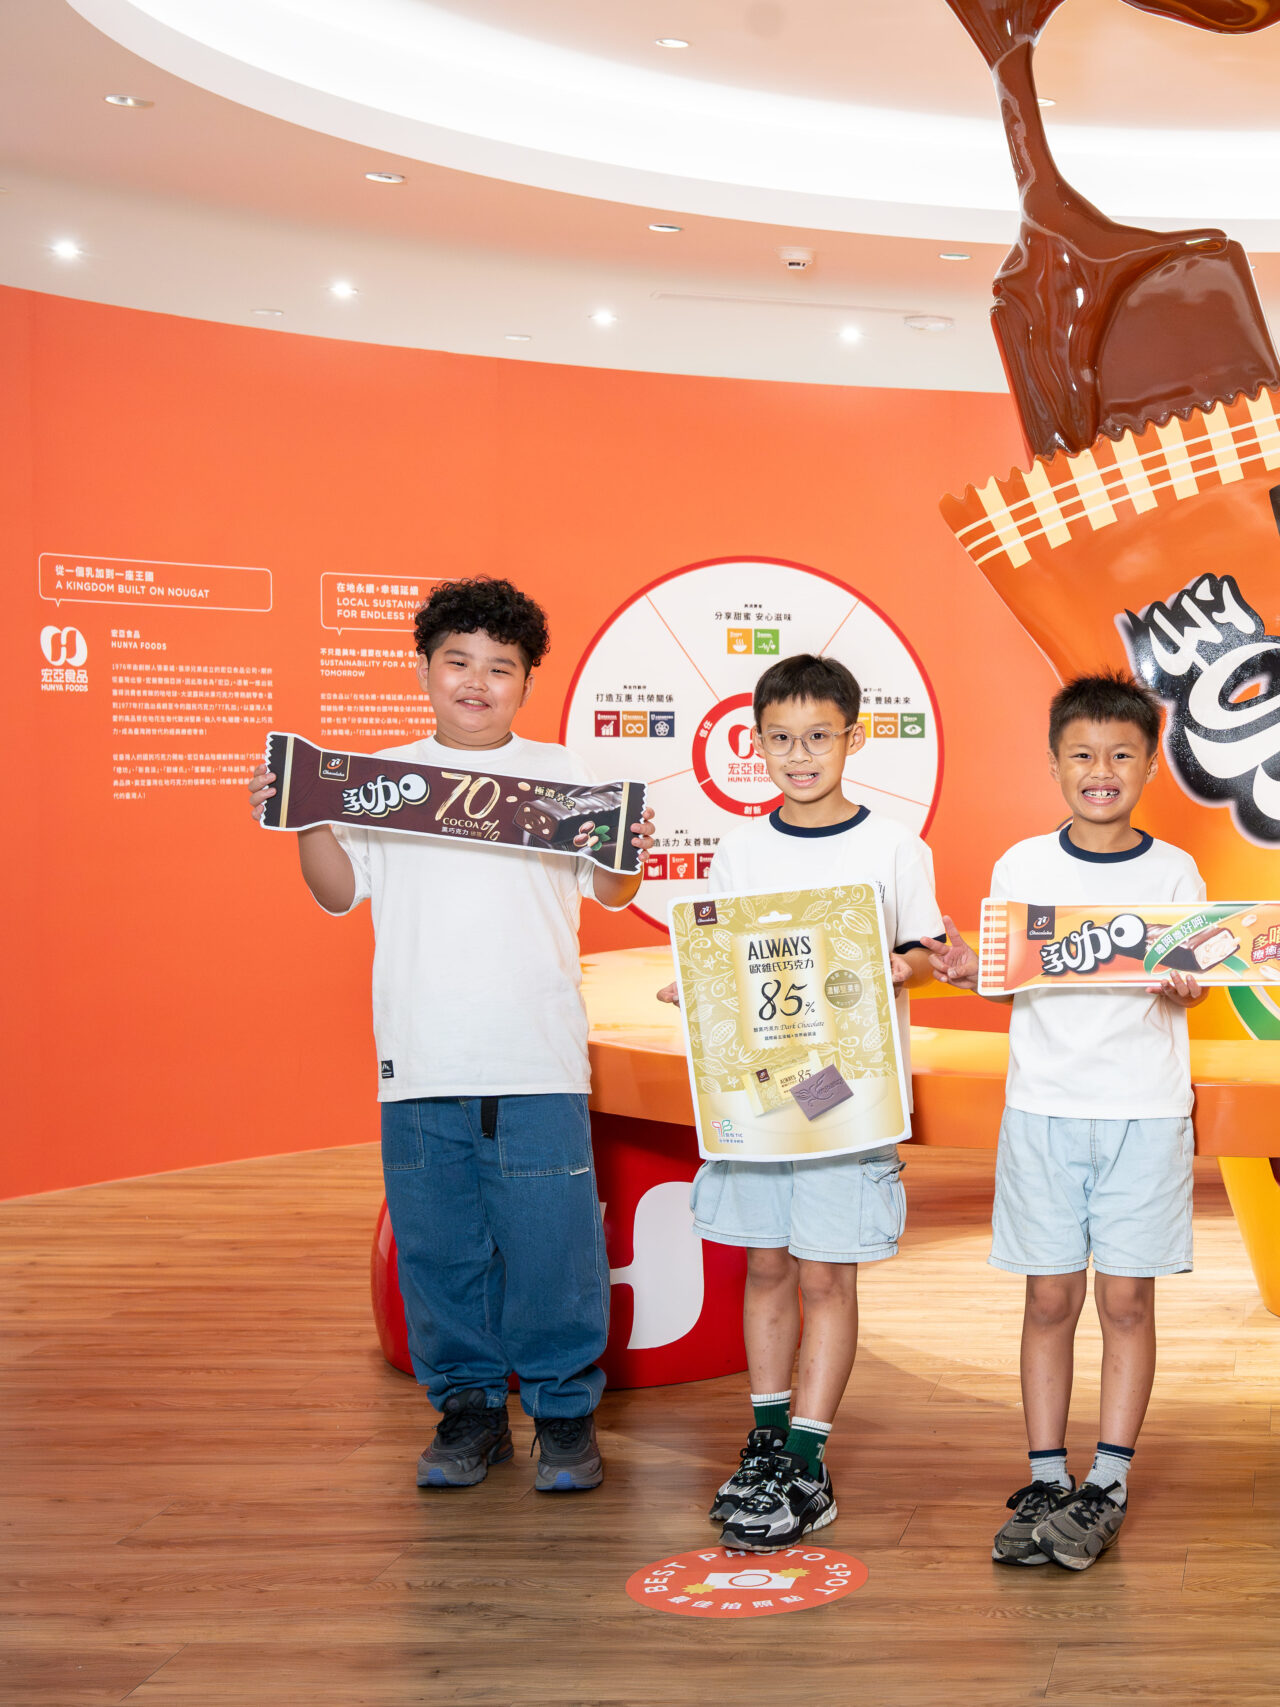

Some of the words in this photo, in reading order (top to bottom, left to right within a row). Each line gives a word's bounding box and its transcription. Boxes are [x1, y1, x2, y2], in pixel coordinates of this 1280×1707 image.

[55, 580, 63, 590] A
[66, 580, 115, 593] KINGDOM
[117, 583, 146, 595] BUILT
[149, 586, 165, 596] ON
[167, 586, 210, 599] NOUGAT
[336, 597, 370, 607] LOCAL
[372, 599, 422, 609] SUSTAINA
[336, 609, 358, 618] FOR
[360, 611, 405, 620] ENDLESS
[111, 640, 138, 650] HUNYA
[140, 641, 167, 651] FOODS
[320, 658, 380, 668] SUSTAINABILITY
[382, 660, 399, 668] FOR
[41, 668, 88, 684] 宏亞食品
[320, 669, 365, 678] TOMORROW
[41, 684, 64, 692] HUNYA
[65, 684, 88, 692] FOODS
[596, 693, 633, 703] 打造互惠
[434, 770, 501, 822] 70
[443, 817, 479, 829] COCOA
[747, 936, 812, 960] ALWAYS
[749, 960, 814, 974] 歐維氏巧克力
[758, 979, 808, 1021] 85
[805, 1001, 816, 1016] %
[780, 1022, 797, 1031] Dark
[643, 1561, 687, 1594] BEST
[813, 1562, 852, 1596] SPOT
